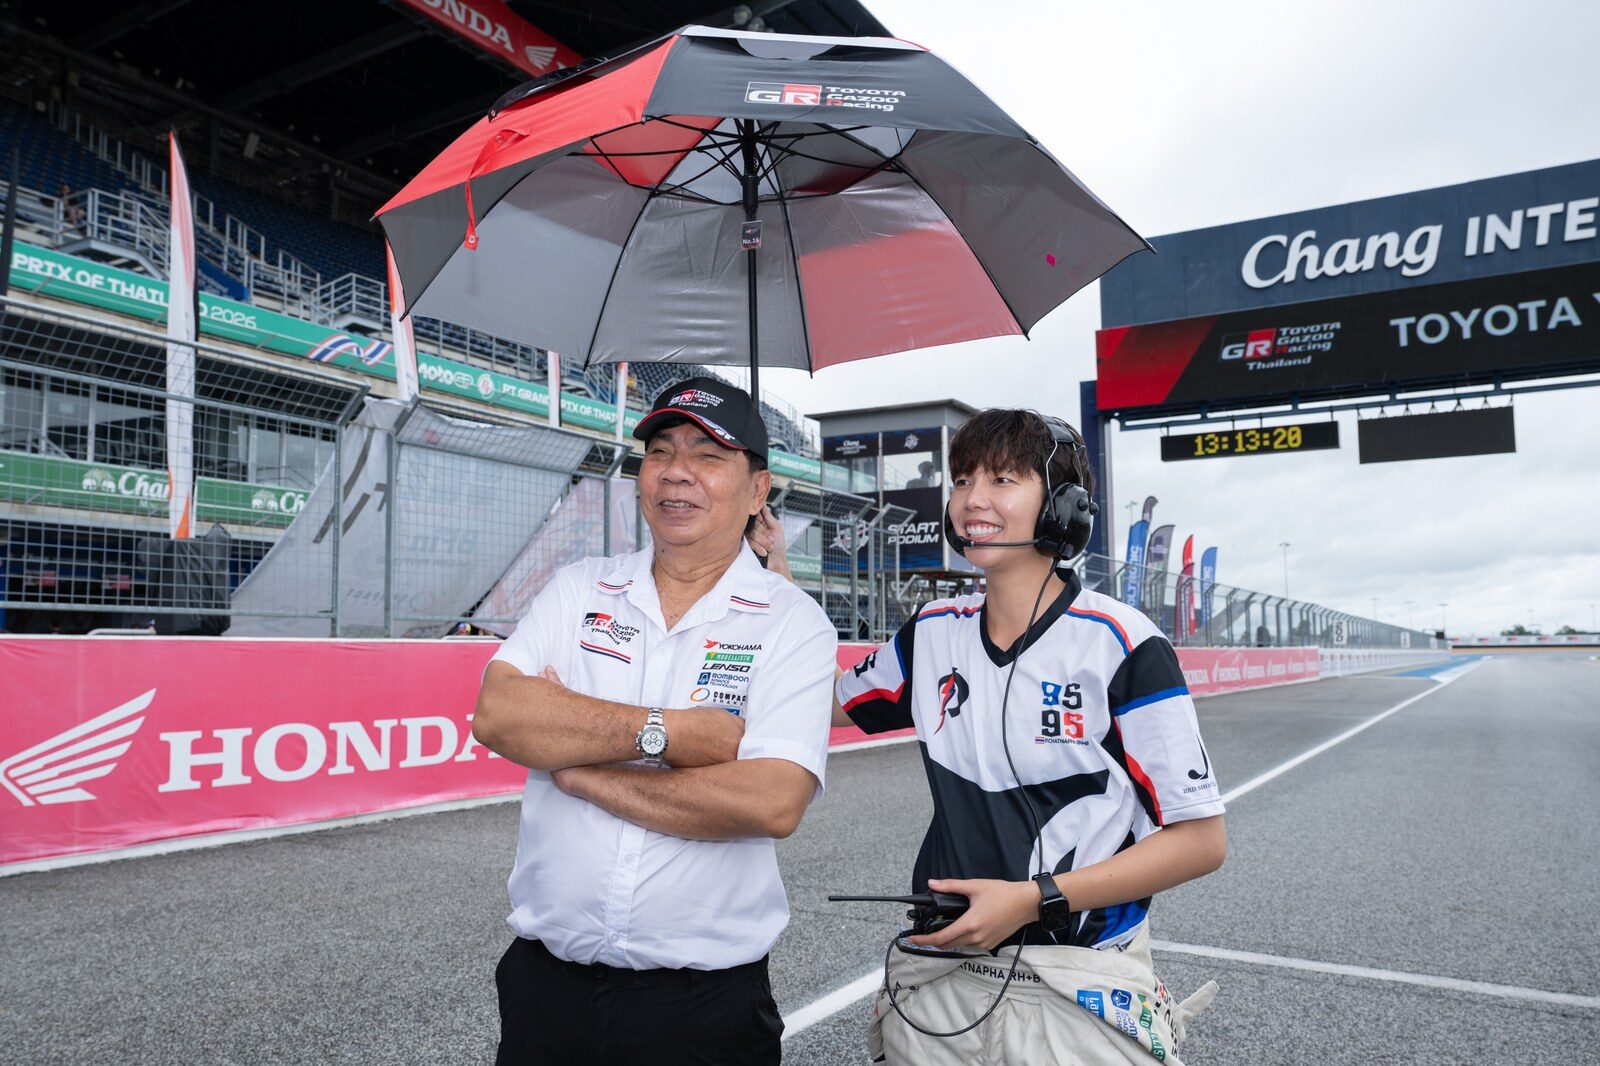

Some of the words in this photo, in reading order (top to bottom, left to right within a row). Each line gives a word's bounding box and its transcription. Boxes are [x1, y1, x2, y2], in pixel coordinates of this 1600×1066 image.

[749, 90, 820, 105] GR
[825, 86, 906, 97] TOYOTA
[827, 94, 899, 104] GAZOO
[826, 100, 894, 112] Racing
[1241, 224, 1443, 289] Chang
[11, 252, 73, 282] PRIX
[75, 270, 104, 290] OF
[1279, 321, 1342, 336] TOYOTA
[1389, 297, 1583, 348] TOYOTA
[1276, 332, 1335, 346] GAZOO
[1221, 341, 1272, 361] GR
[1274, 341, 1331, 356] Racing
[1246, 355, 1313, 371] Thailand
[696, 390, 724, 403] TOYOTA
[1194, 426, 1302, 456] 13:13:20
[887, 521, 940, 535] START
[887, 534, 939, 545] PODIUM
[612, 618, 640, 634] TOYOTA
[591, 628, 620, 645] Thailand
[719, 643, 762, 651] YOKOHAMA
[702, 663, 751, 673] LENSO
[1041, 681, 1083, 710] 95
[1041, 710, 1083, 738] 95
